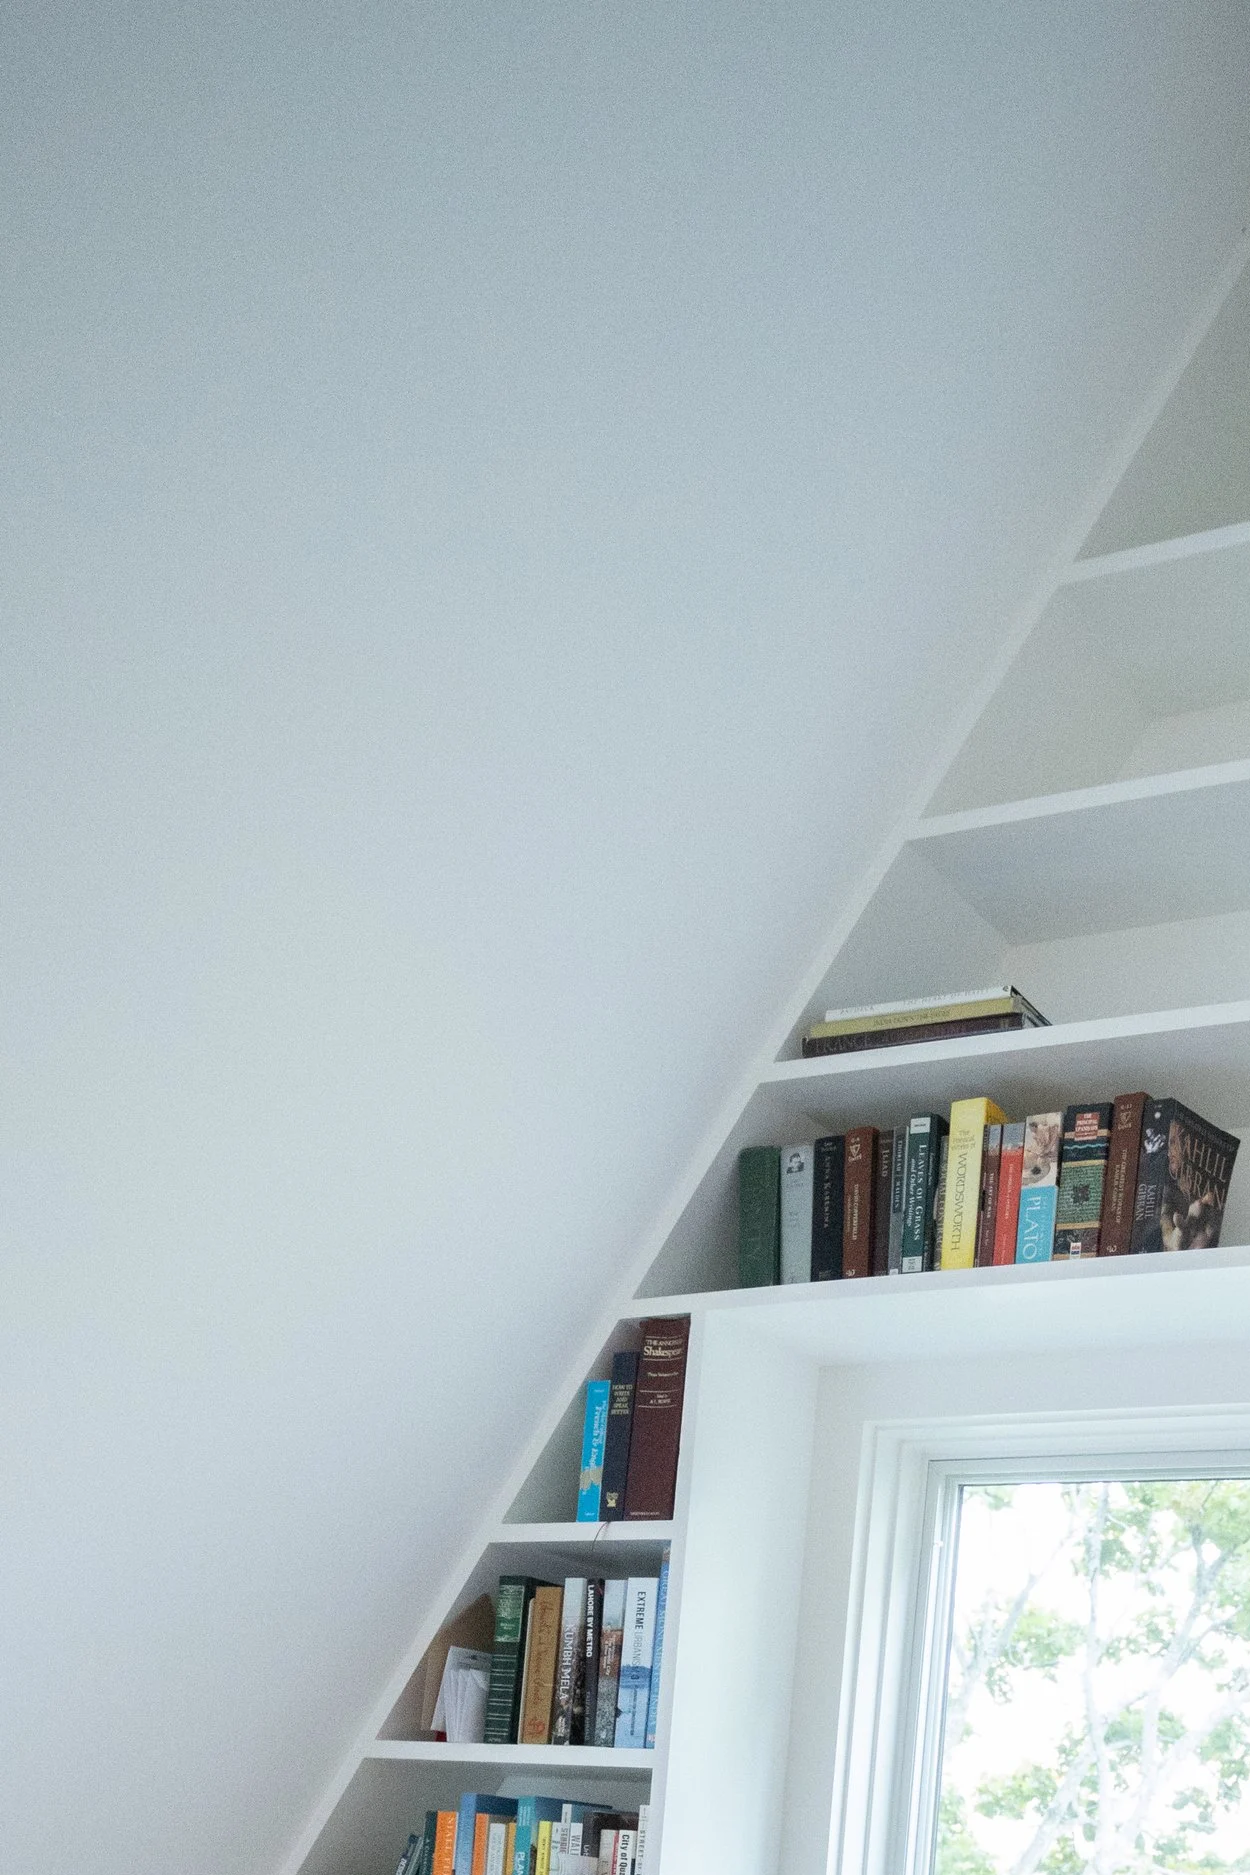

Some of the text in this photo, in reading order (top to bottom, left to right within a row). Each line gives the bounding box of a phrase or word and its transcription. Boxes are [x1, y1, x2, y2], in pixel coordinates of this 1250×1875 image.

[914, 1144, 927, 1241] LEAVES GRASS
[951, 1152, 968, 1250] WORDSWORTH
[1136, 1183, 1146, 1221] GIBRAN
[1144, 1184, 1158, 1218] KAHLIL
[1022, 1196, 1040, 1260] PLATO
[587, 1584, 595, 1617] LAHORE
[635, 1591, 646, 1629] EXTREME
[559, 1623, 574, 1700] KUMBH MELA
[446, 1816, 454, 1853] NIALL
[621, 1834, 629, 1852] City
